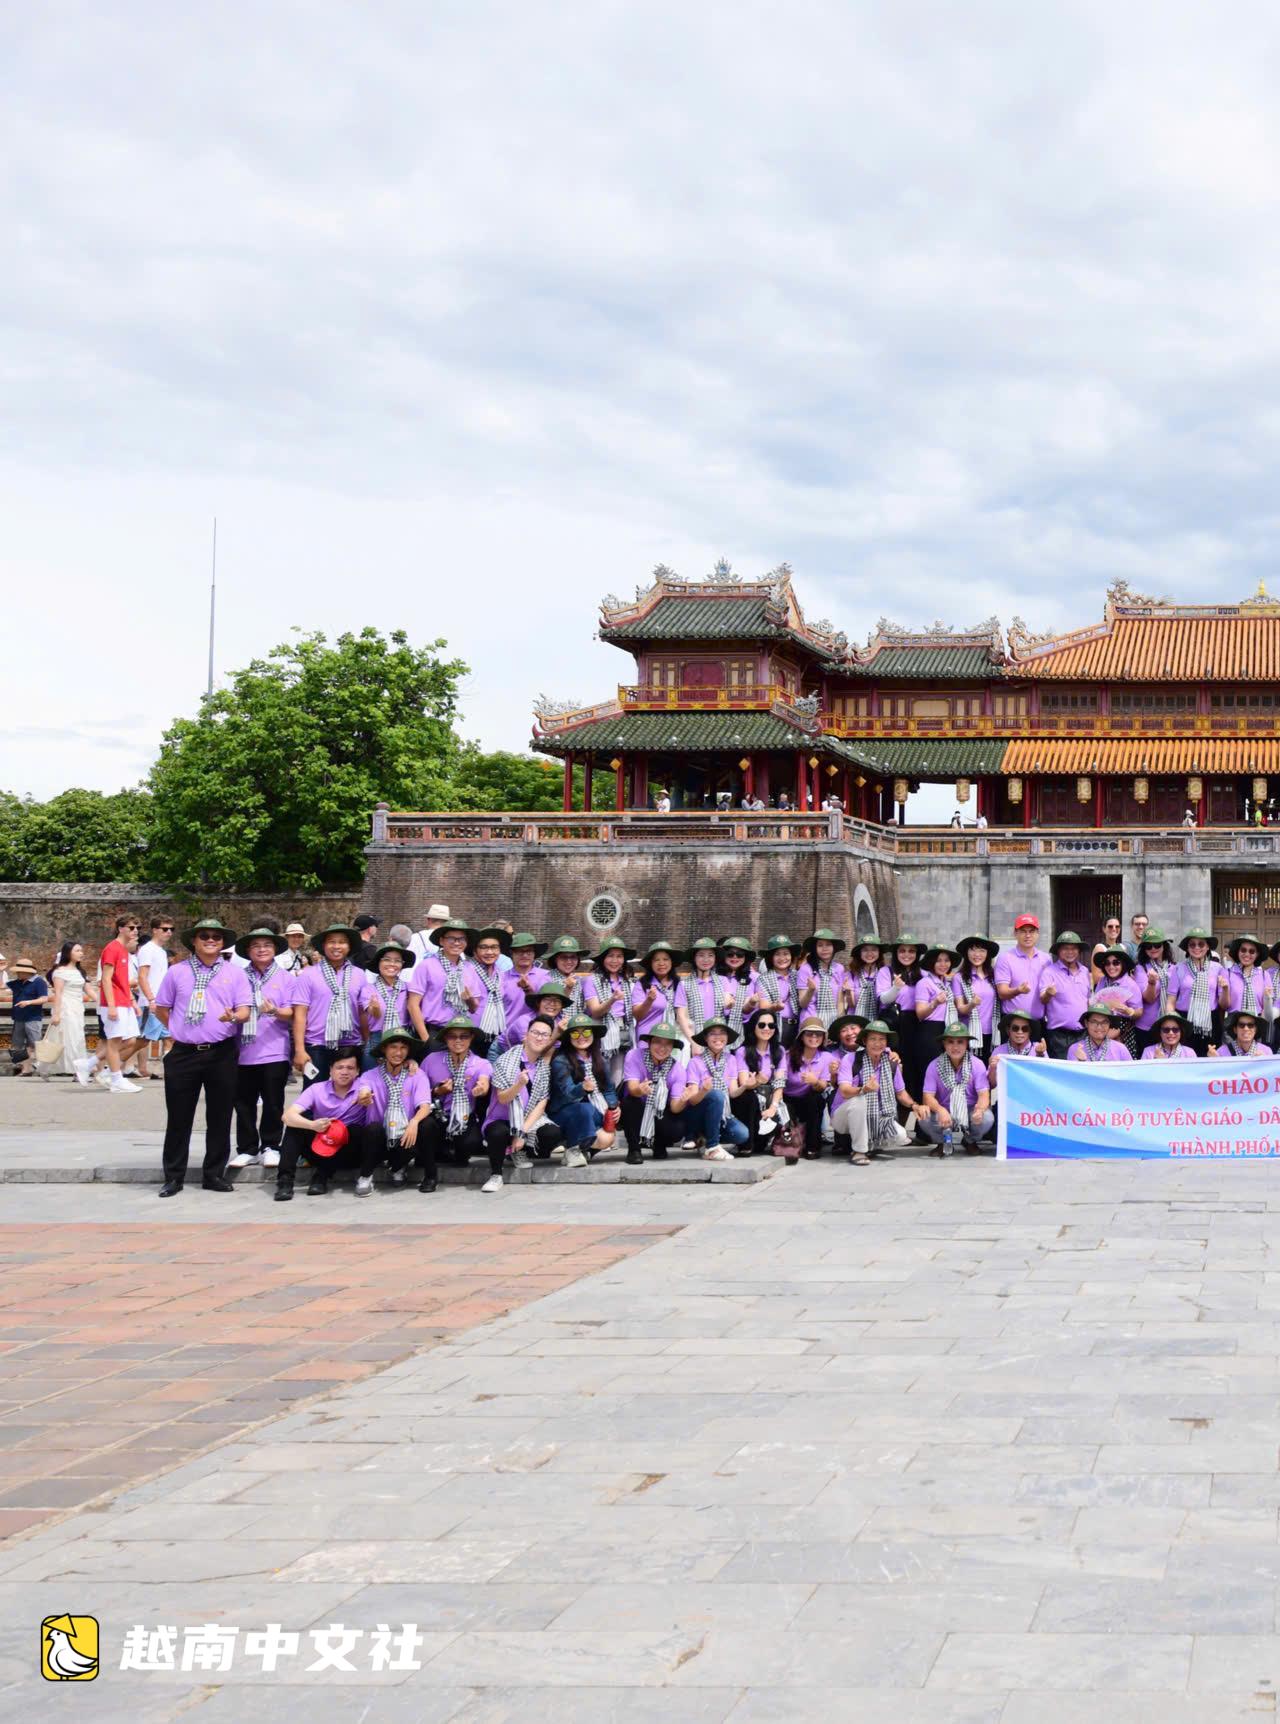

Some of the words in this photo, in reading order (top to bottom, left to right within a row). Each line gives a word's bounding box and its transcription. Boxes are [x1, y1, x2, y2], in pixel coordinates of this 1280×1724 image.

[1207, 1072, 1269, 1096] CHÀO
[1020, 1107, 1067, 1127] ĐOÀN
[1071, 1108, 1106, 1127] CÁN
[1111, 1108, 1134, 1132] BỘ
[1138, 1107, 1198, 1127] TUYÊN
[1201, 1107, 1243, 1126] GIÁO
[1168, 1136, 1231, 1156] THÀNH
[1234, 1135, 1271, 1155] PHỐ
